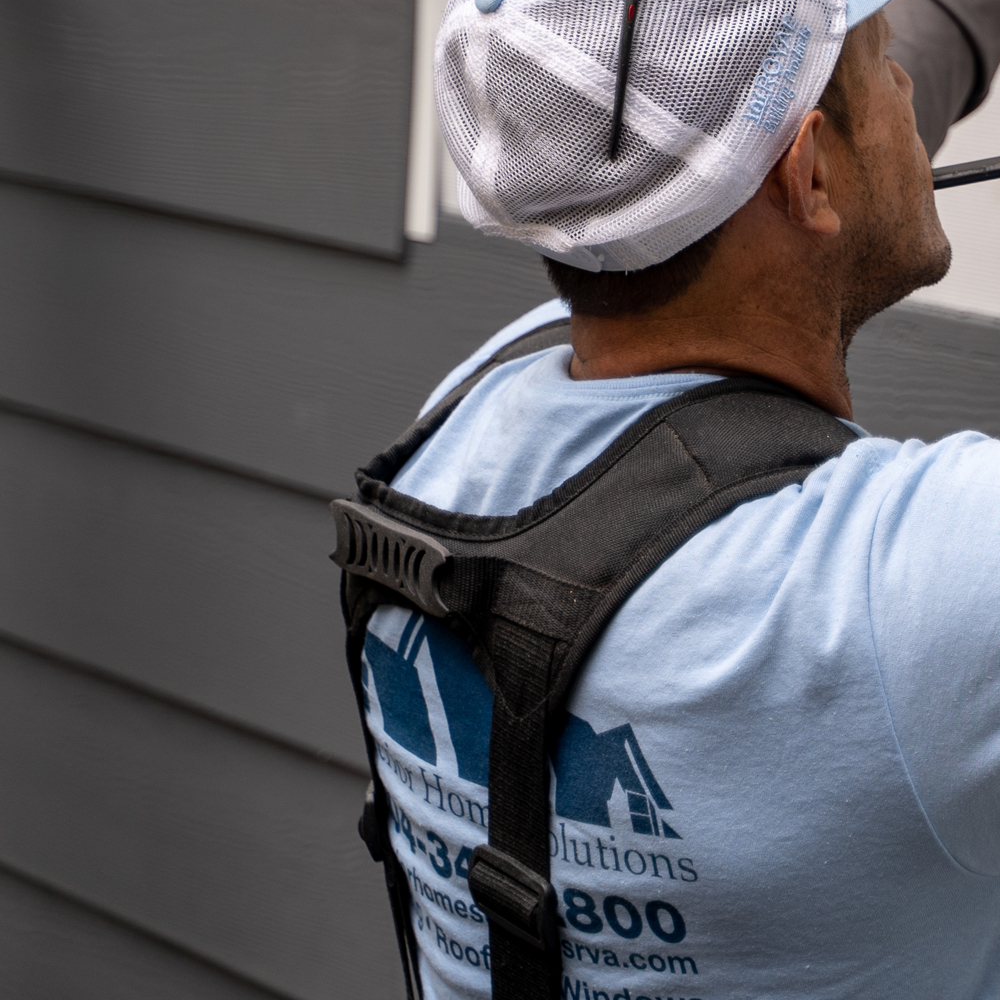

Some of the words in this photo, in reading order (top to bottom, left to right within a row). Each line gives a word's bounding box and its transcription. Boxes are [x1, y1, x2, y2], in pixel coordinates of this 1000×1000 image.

[418, 765, 489, 829] Hom
[550, 822, 699, 883] lutions
[558, 887, 687, 944] 800
[434, 922, 491, 971] Roof
[561, 938, 699, 975] srva.com
